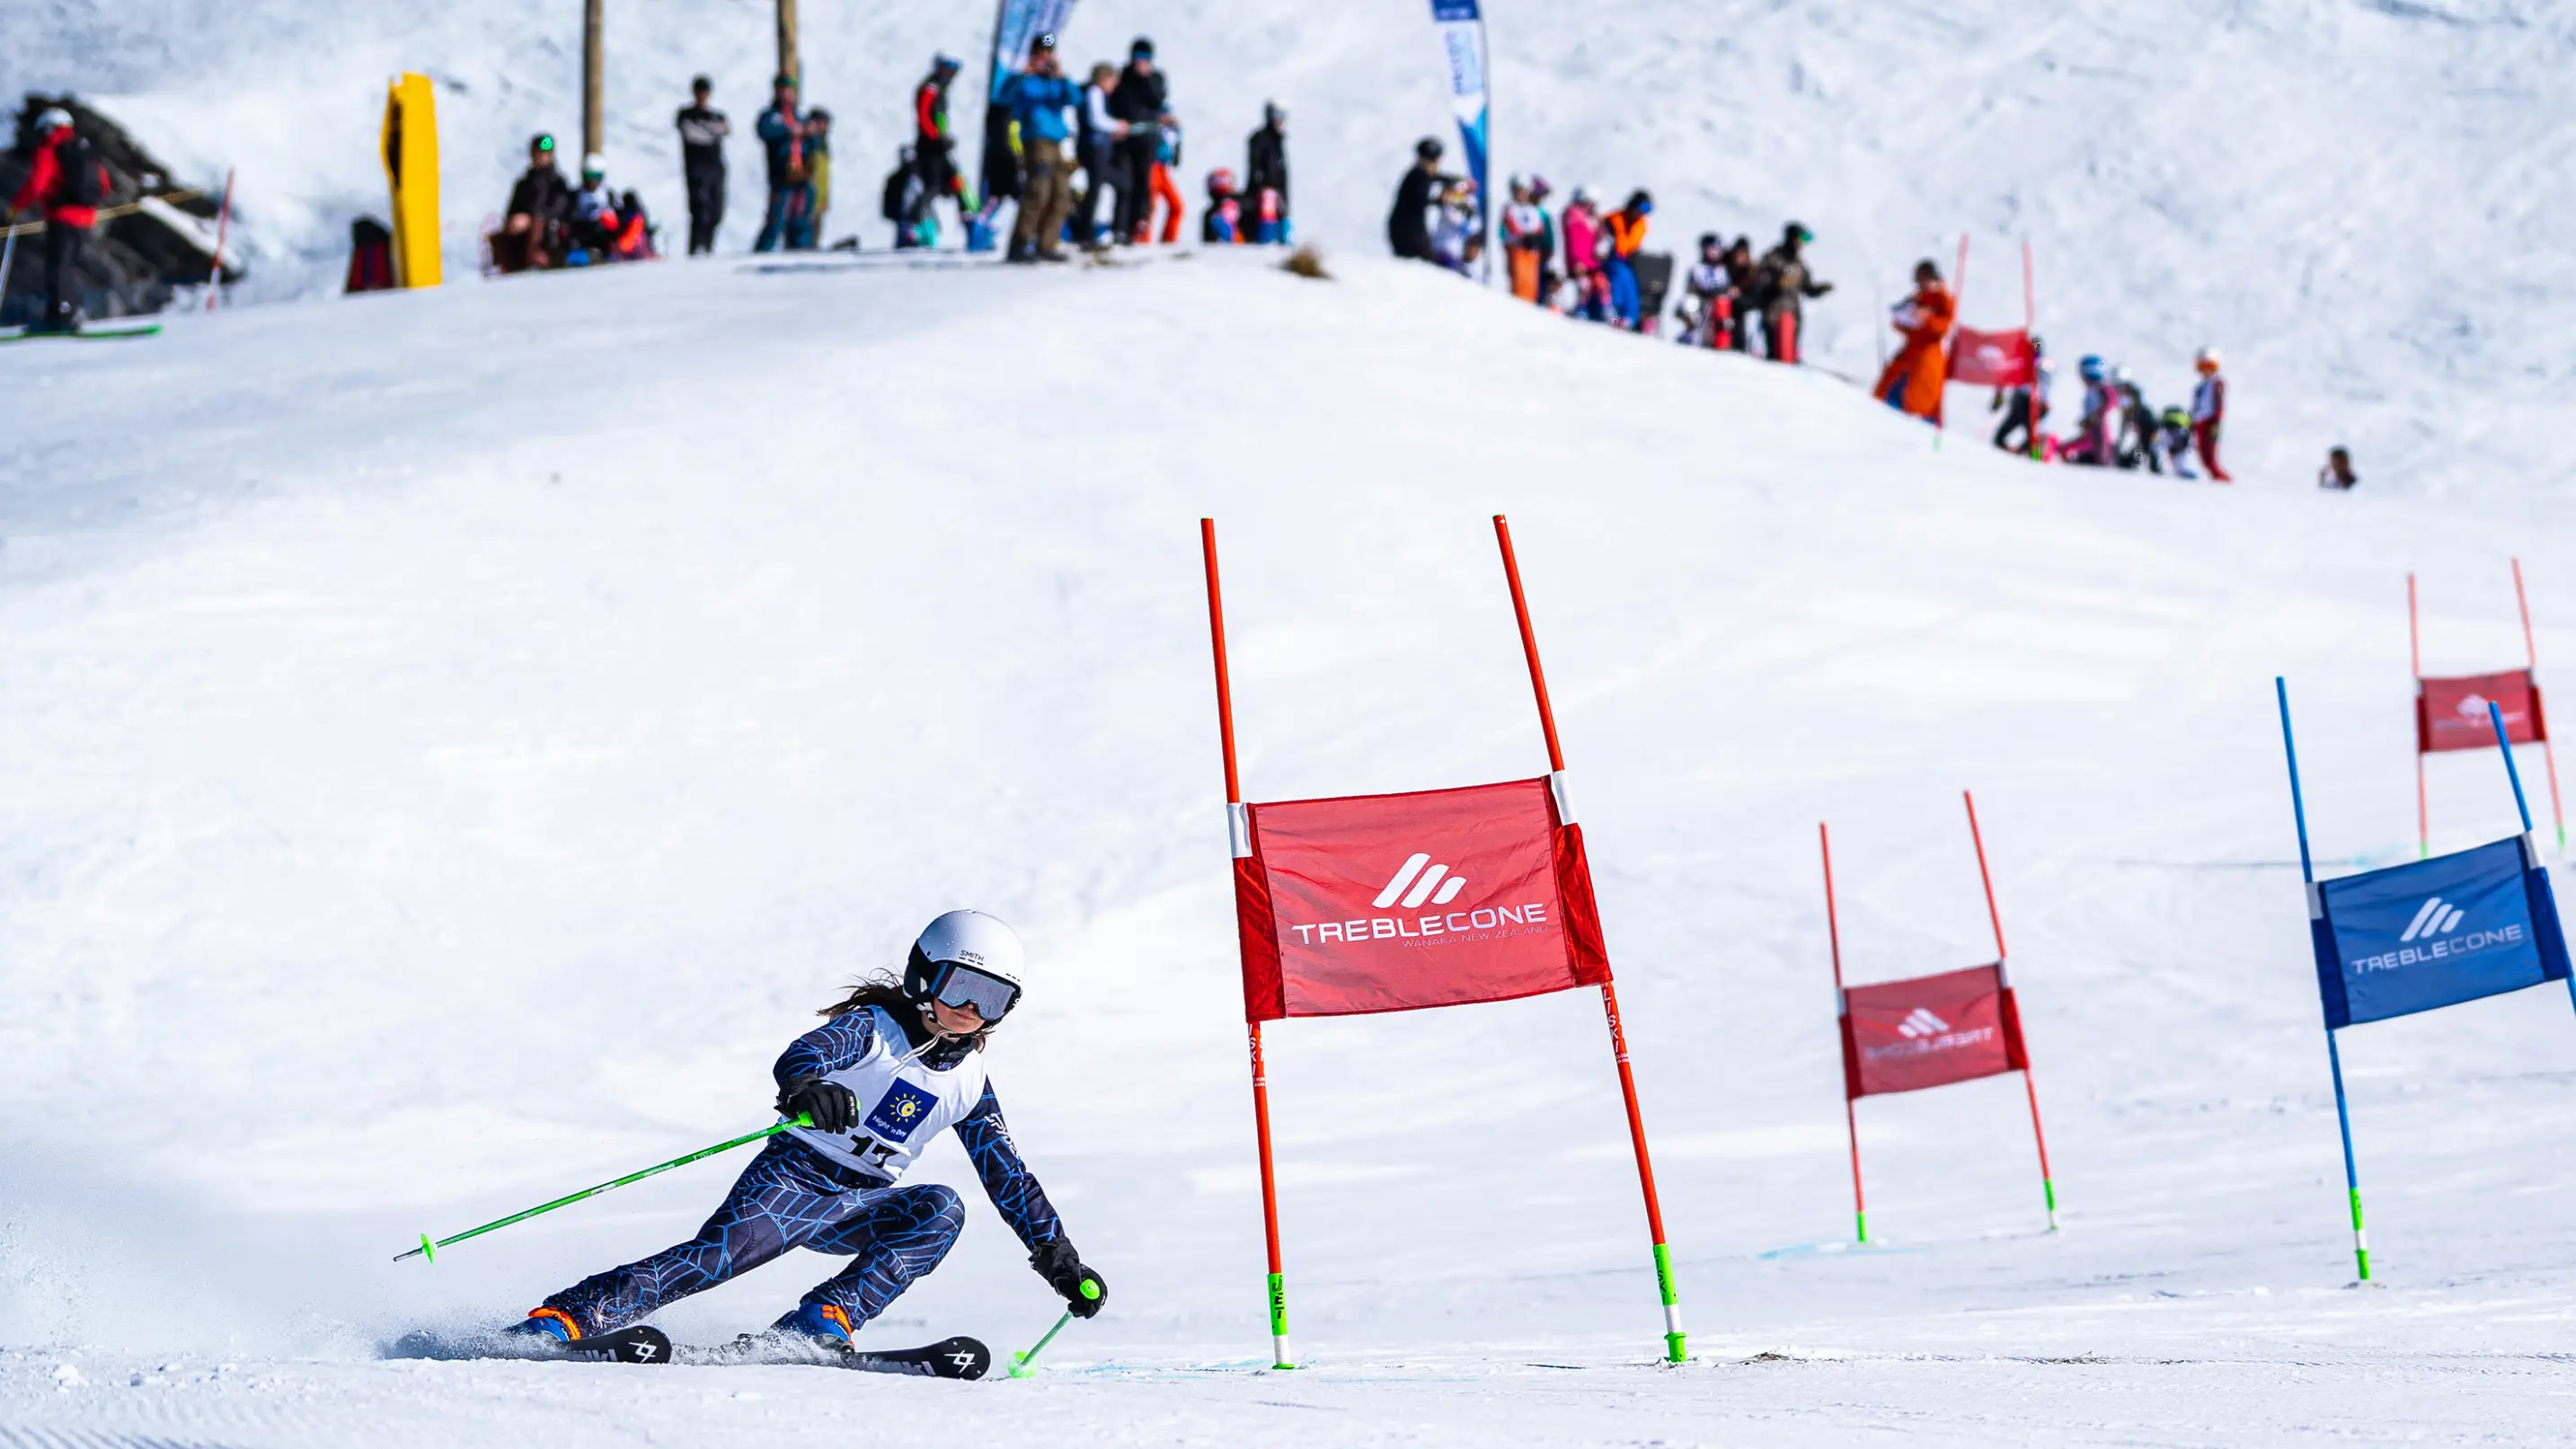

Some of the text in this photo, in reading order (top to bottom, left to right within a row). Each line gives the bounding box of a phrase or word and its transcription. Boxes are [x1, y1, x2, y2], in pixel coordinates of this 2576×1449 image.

[1291, 903, 1548, 945] TREBLECONE
[1402, 925, 1549, 948] WANAKA NEW ZEALAND
[960, 950, 985, 962] SMITH
[2350, 923, 2524, 975] TREBLECONE
[872, 1115, 890, 1130] Night
[895, 1128, 907, 1137] Day
[849, 1134, 900, 1170] 17
